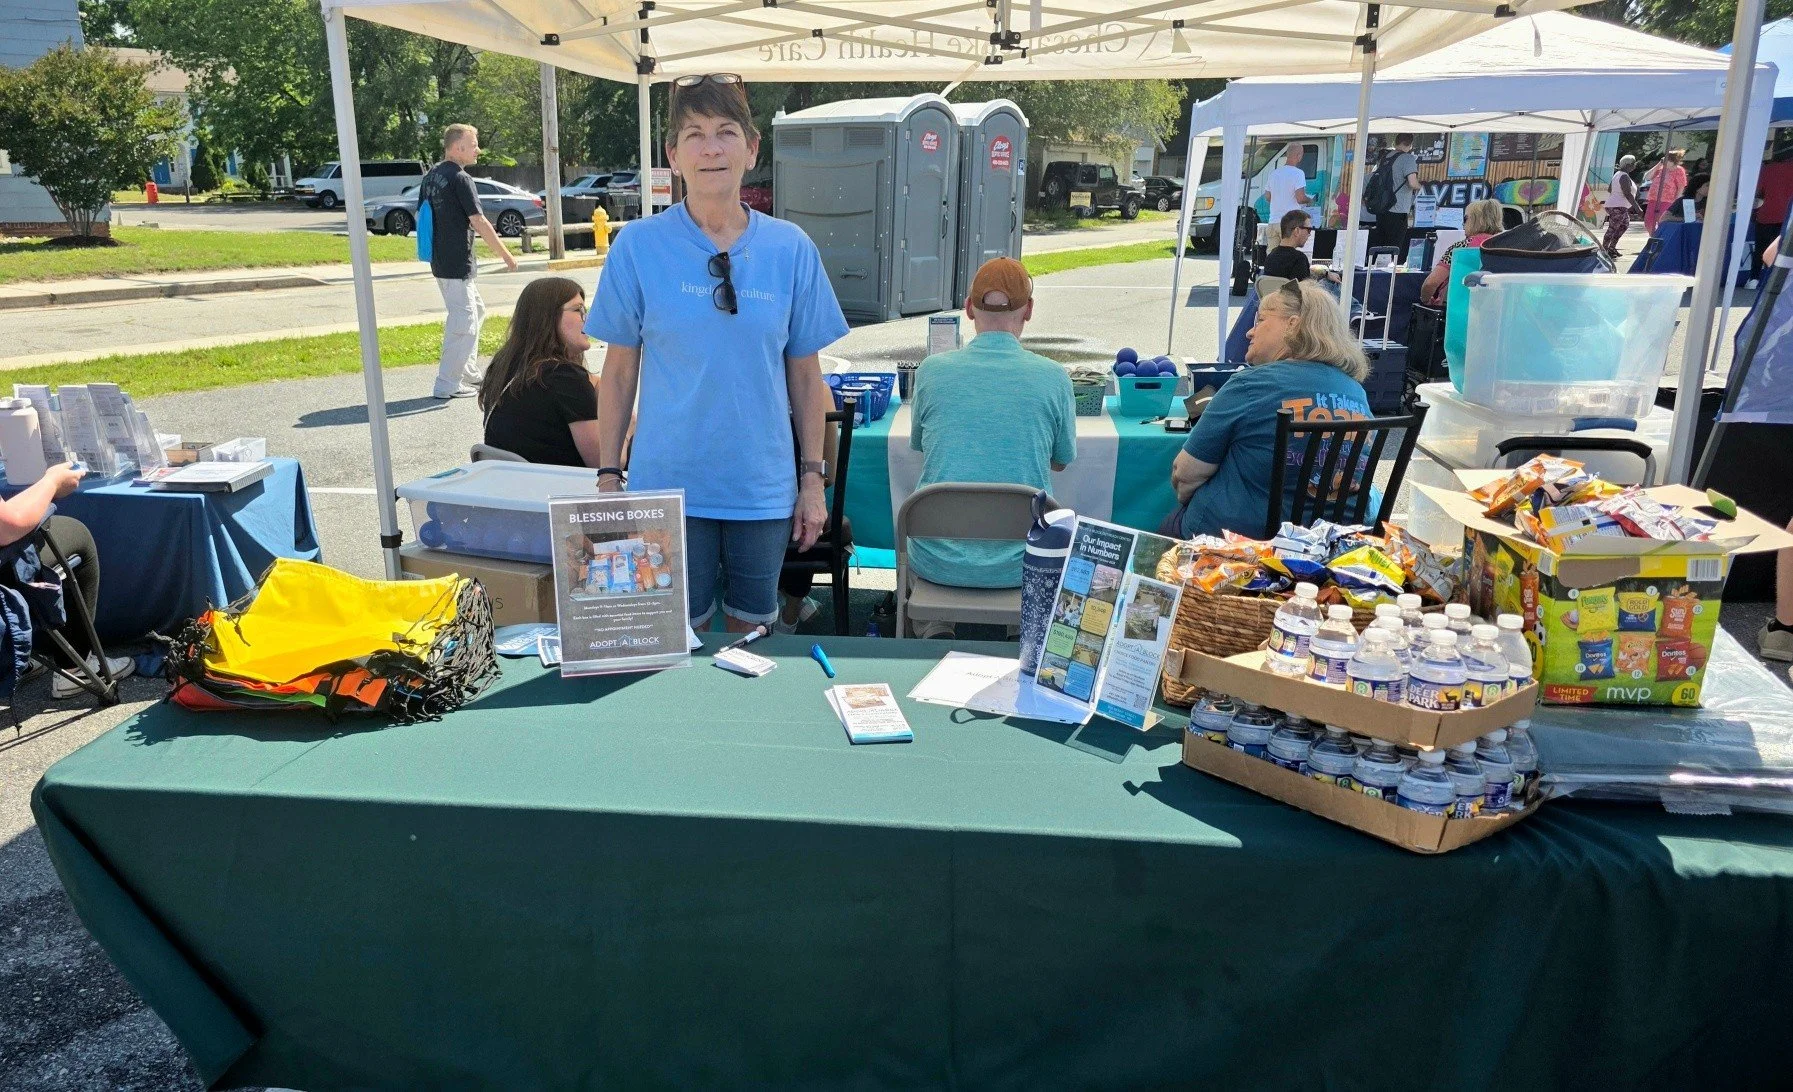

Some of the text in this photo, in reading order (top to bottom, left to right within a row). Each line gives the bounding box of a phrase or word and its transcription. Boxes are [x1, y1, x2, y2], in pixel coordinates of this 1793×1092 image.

[741, 288, 776, 302] culture
[1315, 392, 1329, 409] It
[1328, 393, 1361, 412] Takes
[569, 508, 665, 524] BLESSING BOXES
[1082, 534, 1122, 552] Our Impact
[1087, 544, 1120, 561] Numbers
[589, 639, 618, 648] ADOPT
[633, 636, 660, 645] BLOCK
[1661, 650, 1687, 658] Doritos
[1410, 684, 1439, 700] DEER
[1553, 686, 1589, 696] LIMITED
[1560, 694, 1581, 702] TIME
[1606, 687, 1652, 703] mvp
[1681, 687, 1696, 700] 60
[1409, 692, 1439, 709] PARK
[1457, 802, 1474, 811] ER
[1455, 810, 1474, 819] RK
